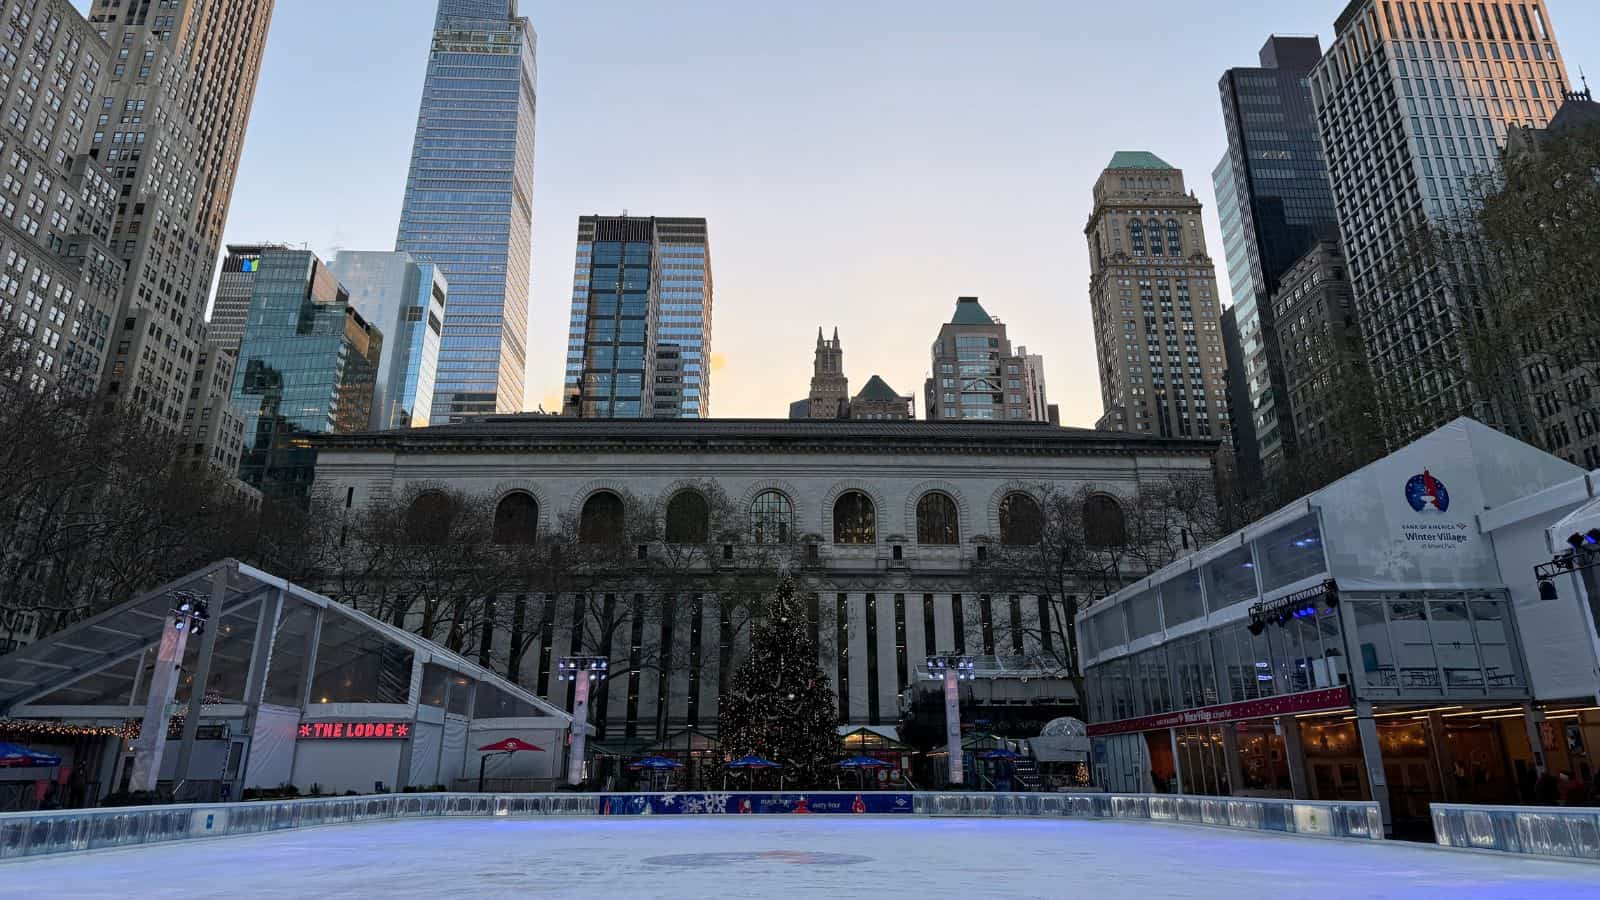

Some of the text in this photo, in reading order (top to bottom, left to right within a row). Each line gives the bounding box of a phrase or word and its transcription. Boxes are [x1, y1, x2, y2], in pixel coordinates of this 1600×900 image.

[1405, 532, 1467, 543] Winter Village
[314, 722, 395, 737] THE LODGE
